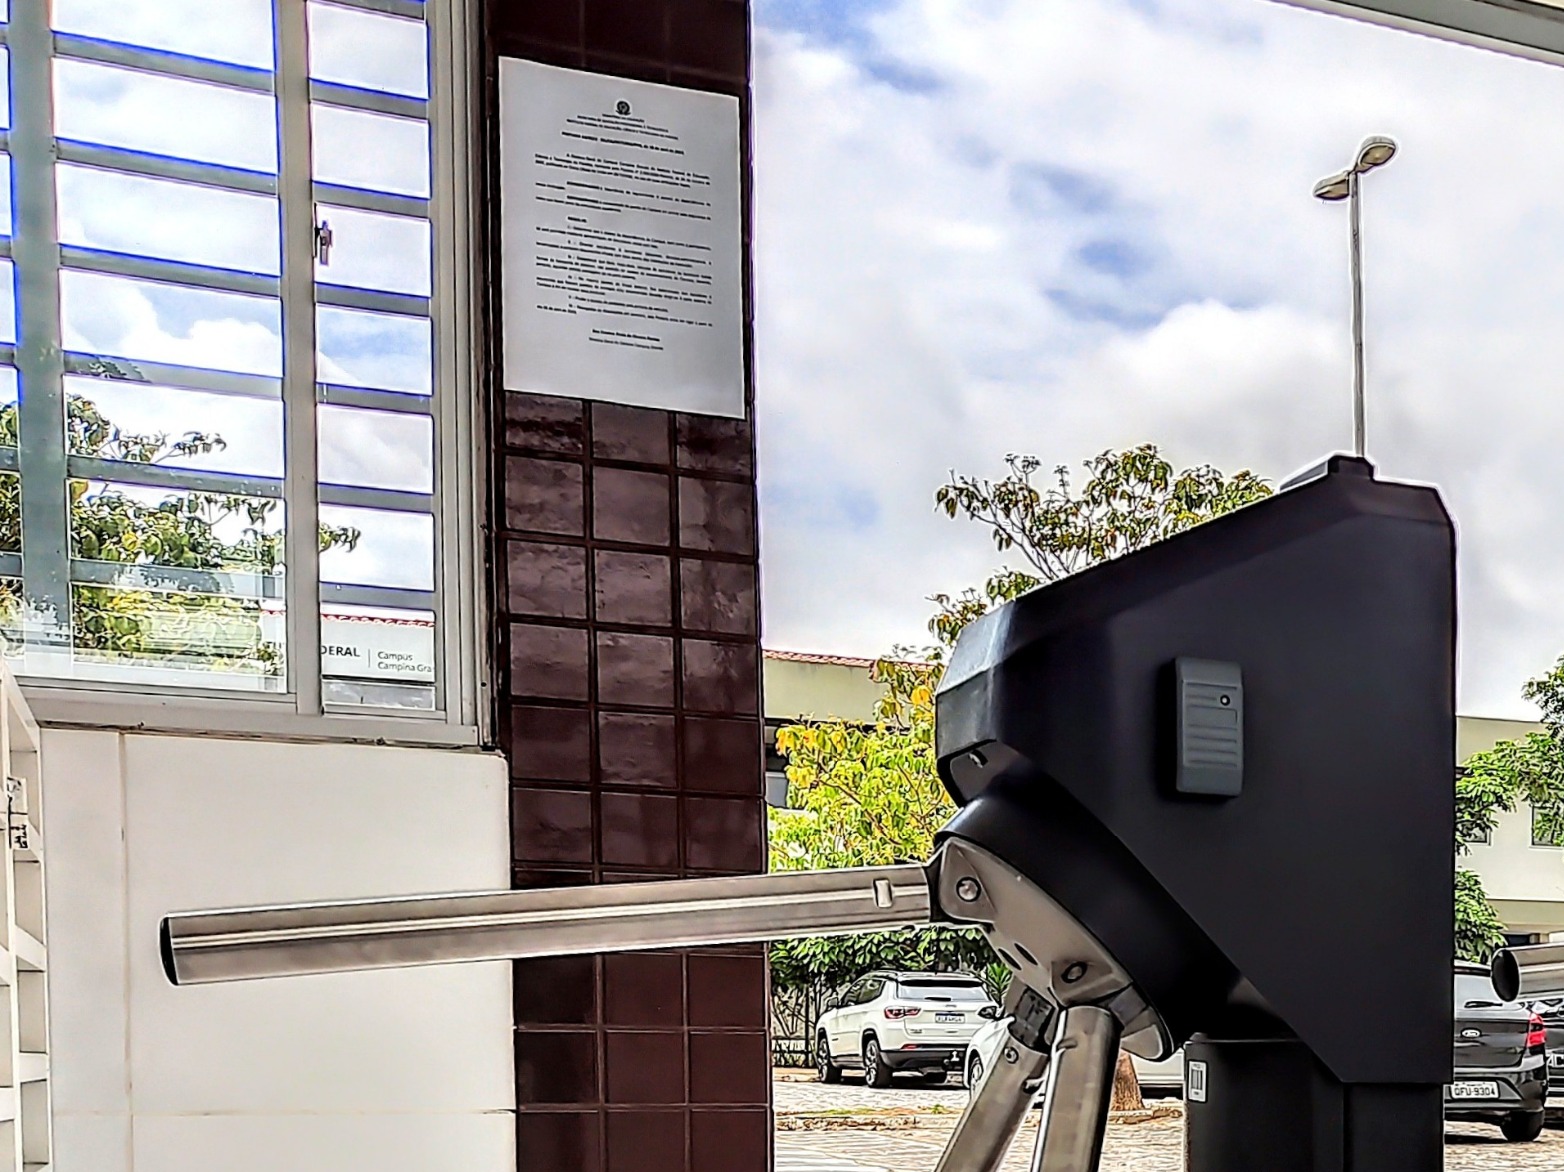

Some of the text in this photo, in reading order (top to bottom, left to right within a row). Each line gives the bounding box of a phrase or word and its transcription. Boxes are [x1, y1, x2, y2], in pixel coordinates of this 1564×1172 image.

[377, 651, 413, 661] Campus
[377, 661, 434, 673] Campina Gra
